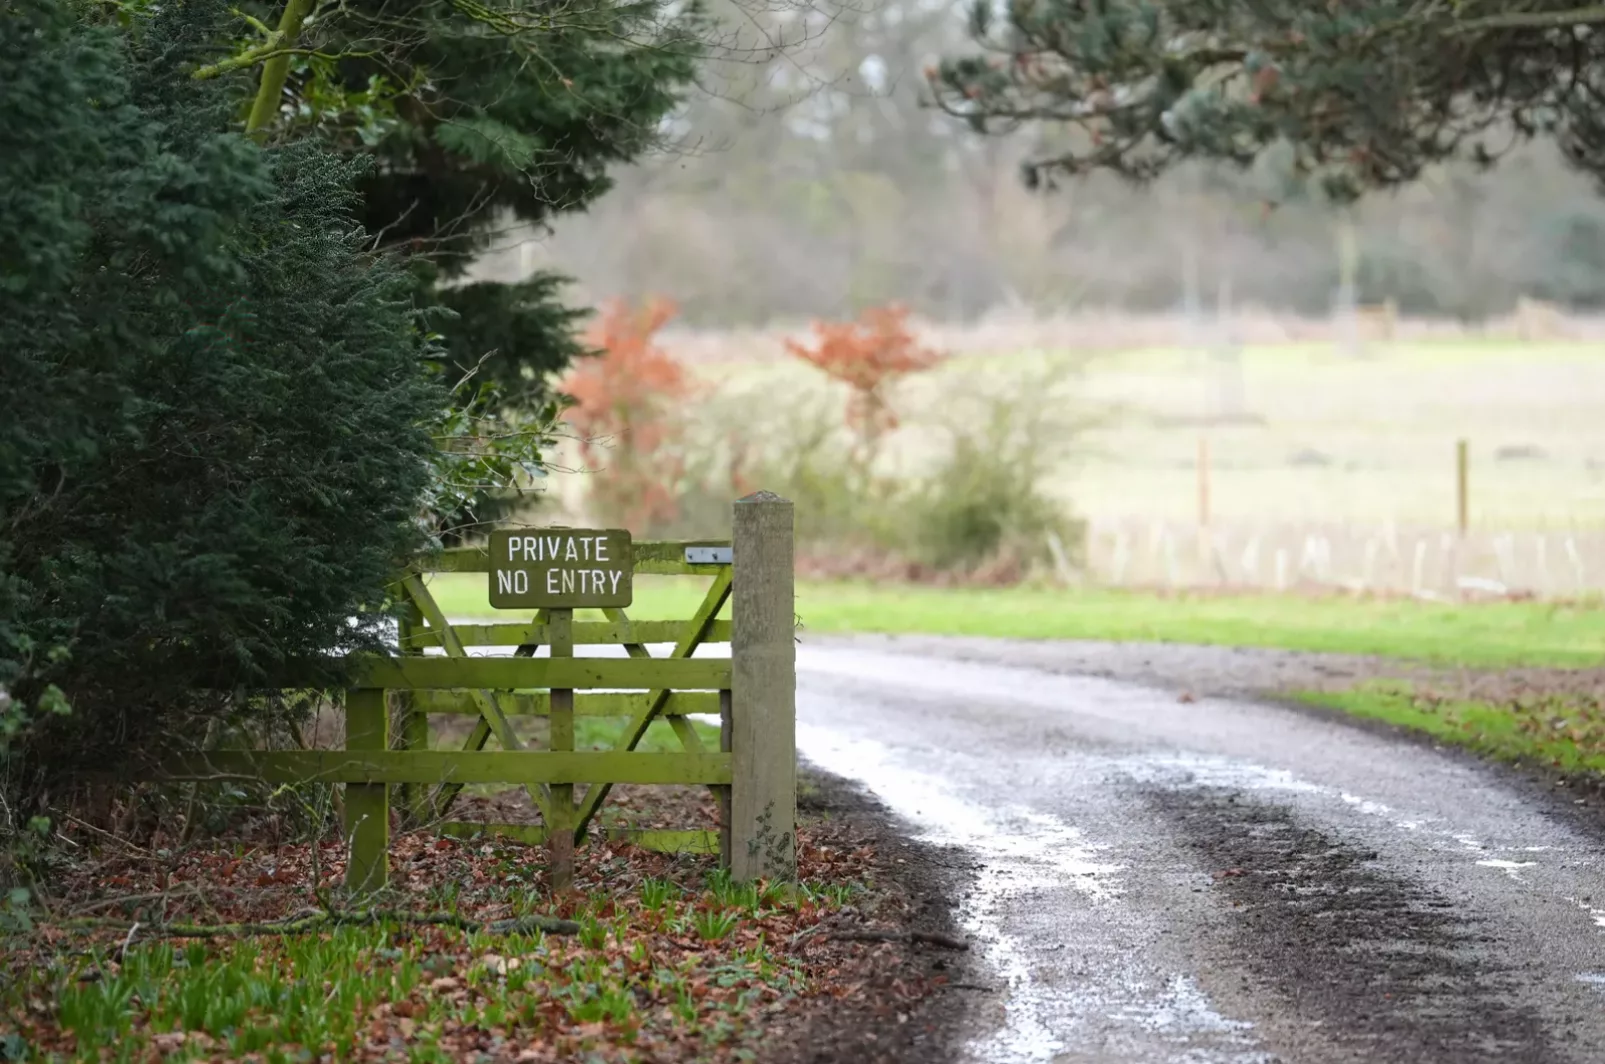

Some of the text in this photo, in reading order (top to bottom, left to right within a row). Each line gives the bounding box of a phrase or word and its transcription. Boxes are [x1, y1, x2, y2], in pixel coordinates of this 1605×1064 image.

[508, 536, 609, 562] PRIVATE
[497, 568, 623, 595] NO ENTRY
